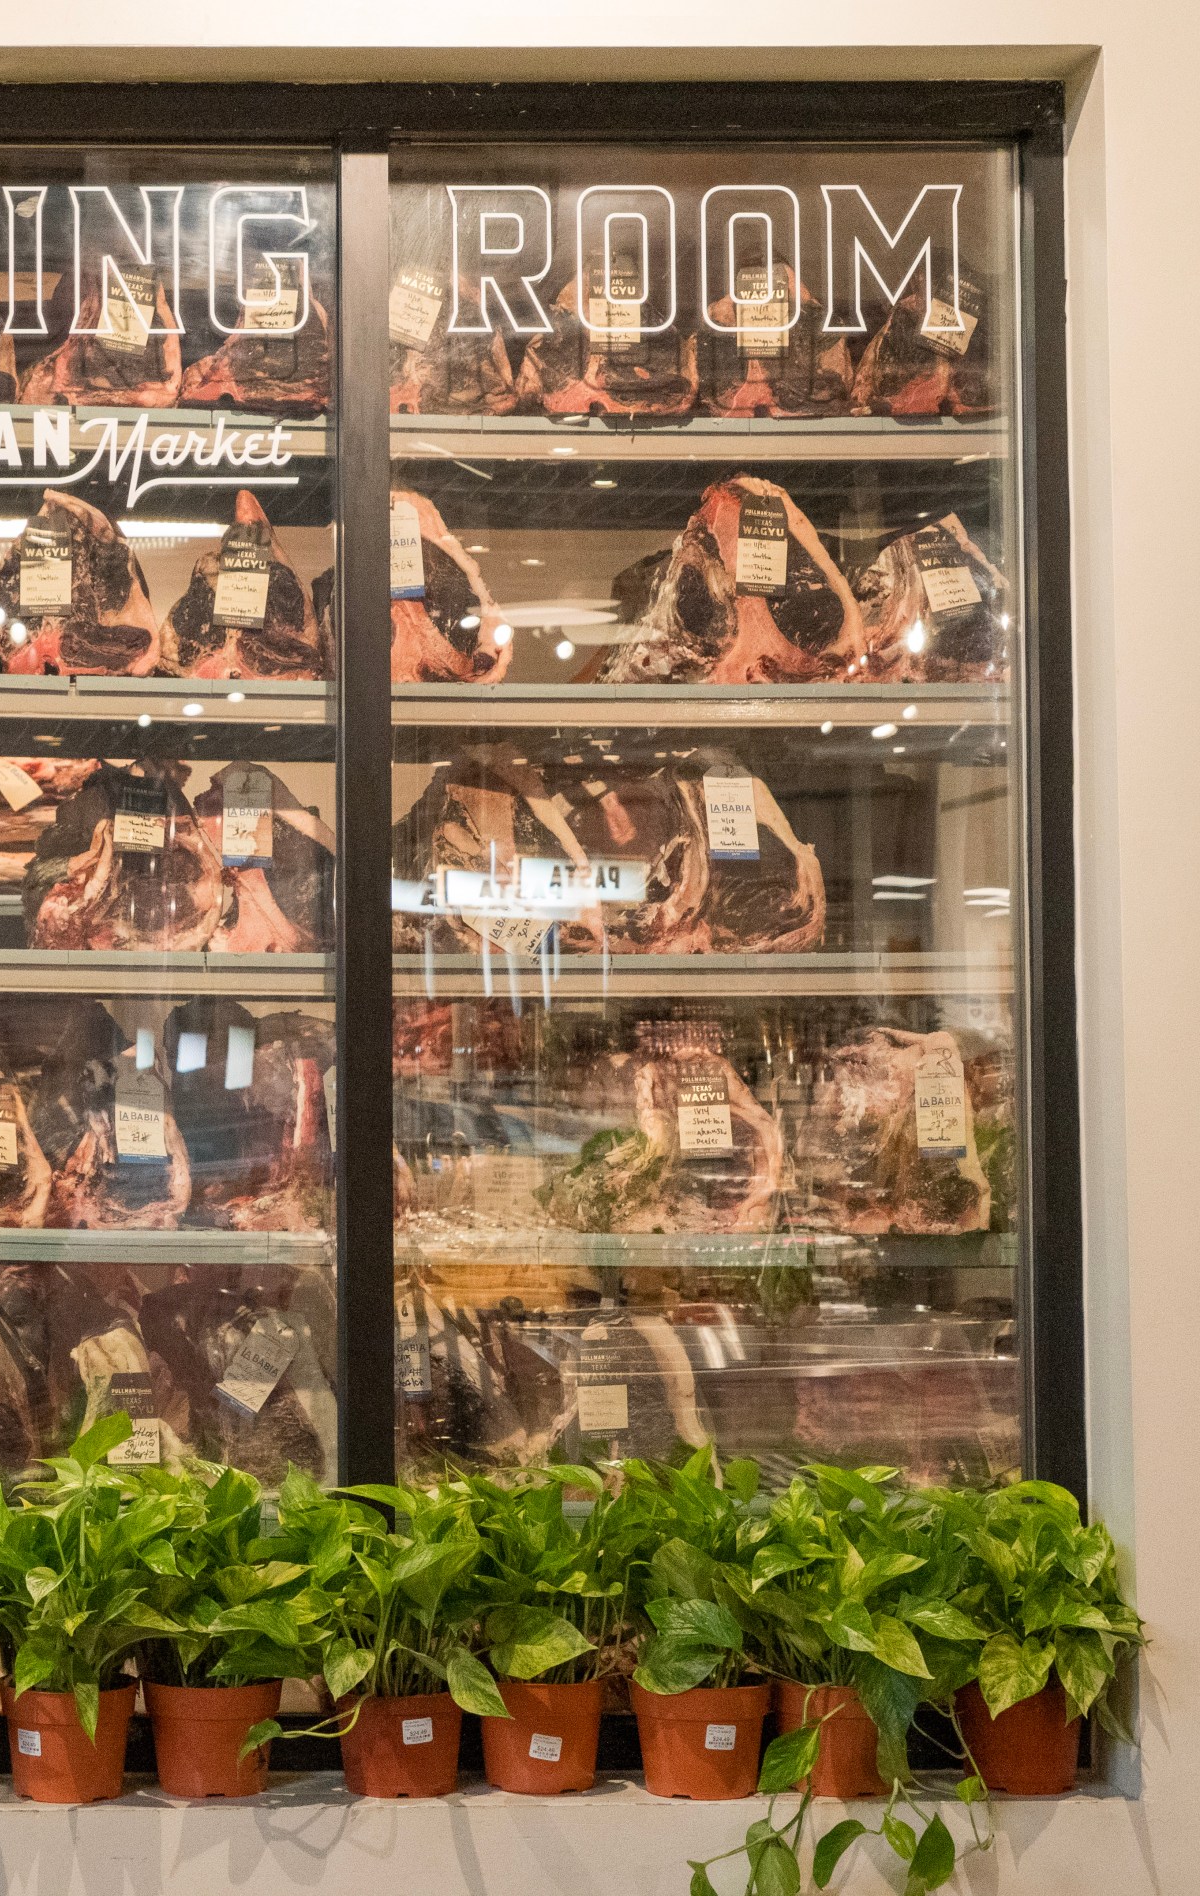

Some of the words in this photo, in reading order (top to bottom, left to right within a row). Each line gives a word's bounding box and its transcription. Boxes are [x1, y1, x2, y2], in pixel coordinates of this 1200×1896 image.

[446, 183, 964, 333] ROOM
[415, 271, 434, 284] TEXAS
[400, 274, 442, 297] WAGYU
[592, 285, 637, 296] WGYU
[751, 282, 771, 291] TEXA
[739, 288, 786, 300] WAGYU
[79, 413, 294, 508] Market
[744, 508, 770, 518] PULLMAN
[754, 519, 774, 528] TEXAS
[742, 526, 786, 539] WAGYU
[25, 546, 69, 558] WAGYU
[237, 550, 258, 559] TEXAS
[224, 558, 268, 571] WAGYU
[239, 808, 270, 819] BABIA
[710, 803, 721, 814] LA
[721, 803, 753, 814] BABIA
[681, 1076, 707, 1085] PULLMAN
[691, 1083, 713, 1093] TEXAS
[680, 1092, 726, 1104] WAGYU
[919, 1096, 931, 1108] LA
[931, 1096, 962, 1106] BABIA
[119, 1110, 130, 1122] LA
[131, 1111, 161, 1123] BABIA
[241, 1347, 253, 1361] LA
[251, 1352, 279, 1379] BABIA
[111, 1387, 137, 1395] PULLMAN
